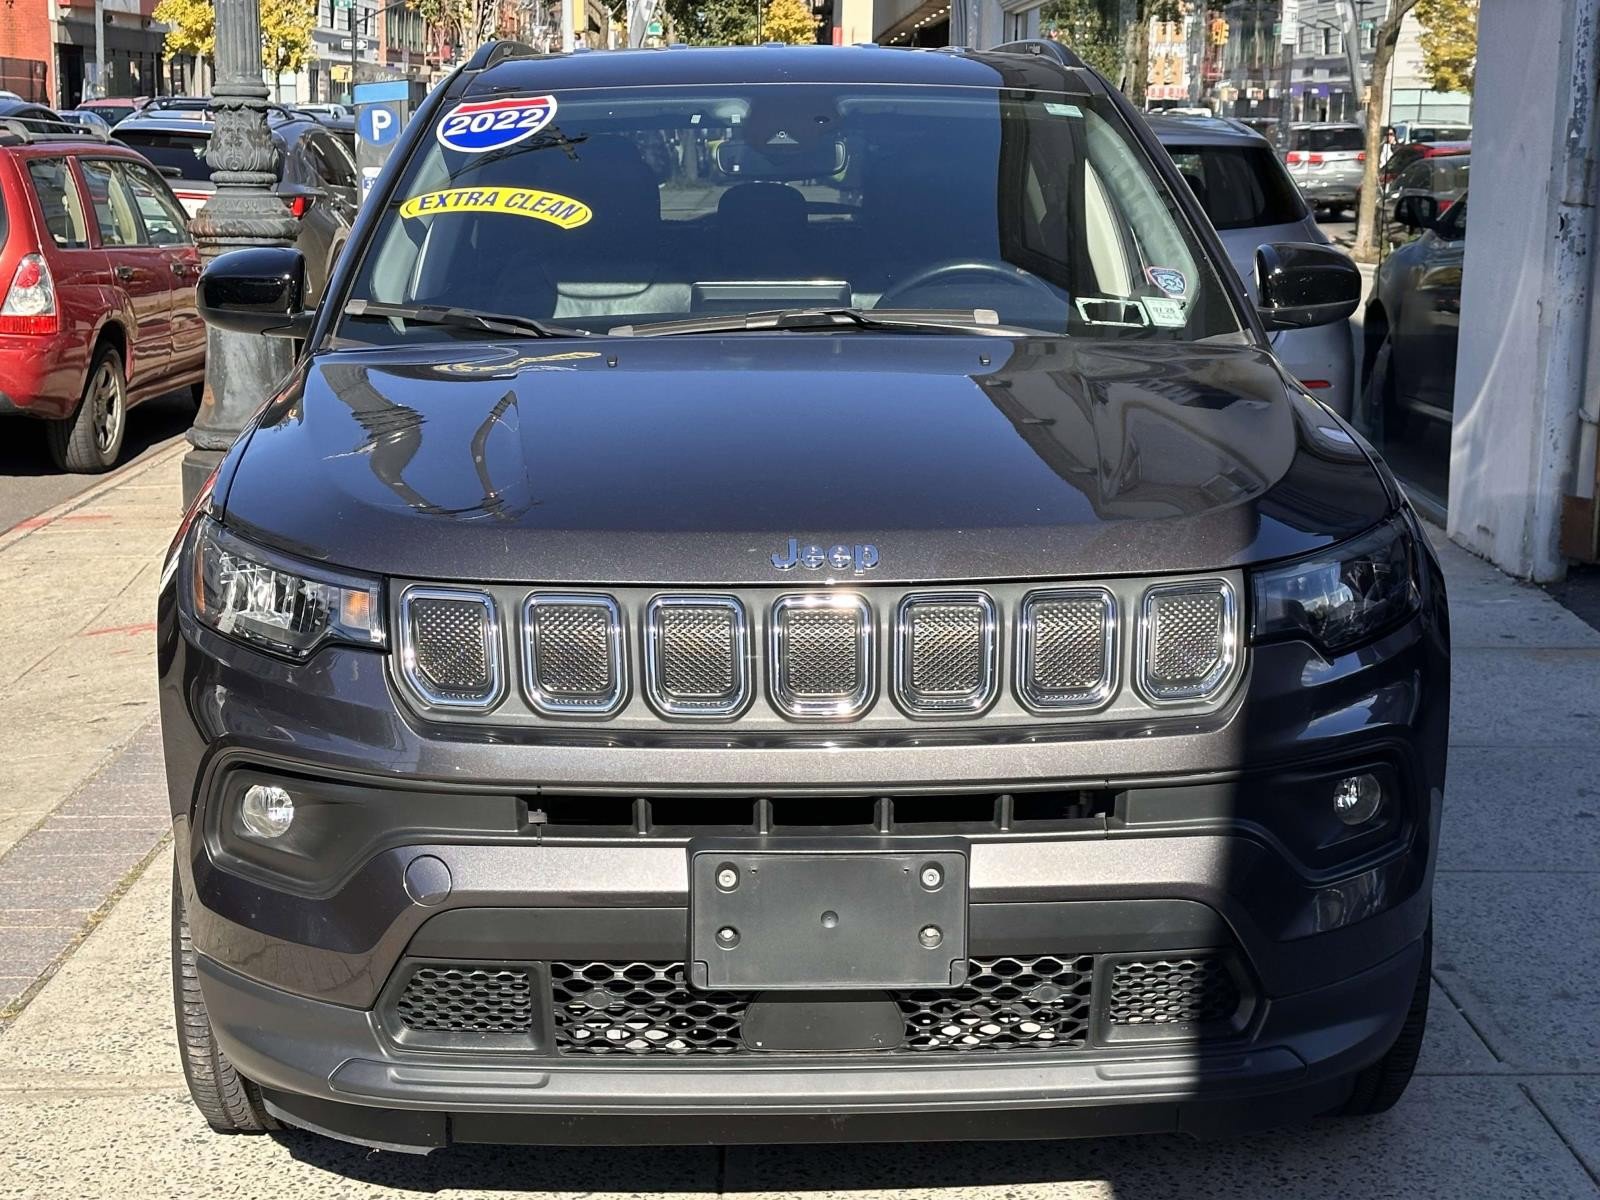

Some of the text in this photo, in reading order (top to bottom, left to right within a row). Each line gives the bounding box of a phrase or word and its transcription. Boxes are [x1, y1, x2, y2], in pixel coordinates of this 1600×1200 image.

[371, 109, 392, 141] P
[443, 108, 545, 137] 2022
[418, 191, 582, 220] EXTRA CLEAN
[771, 538, 879, 575] Jeep
